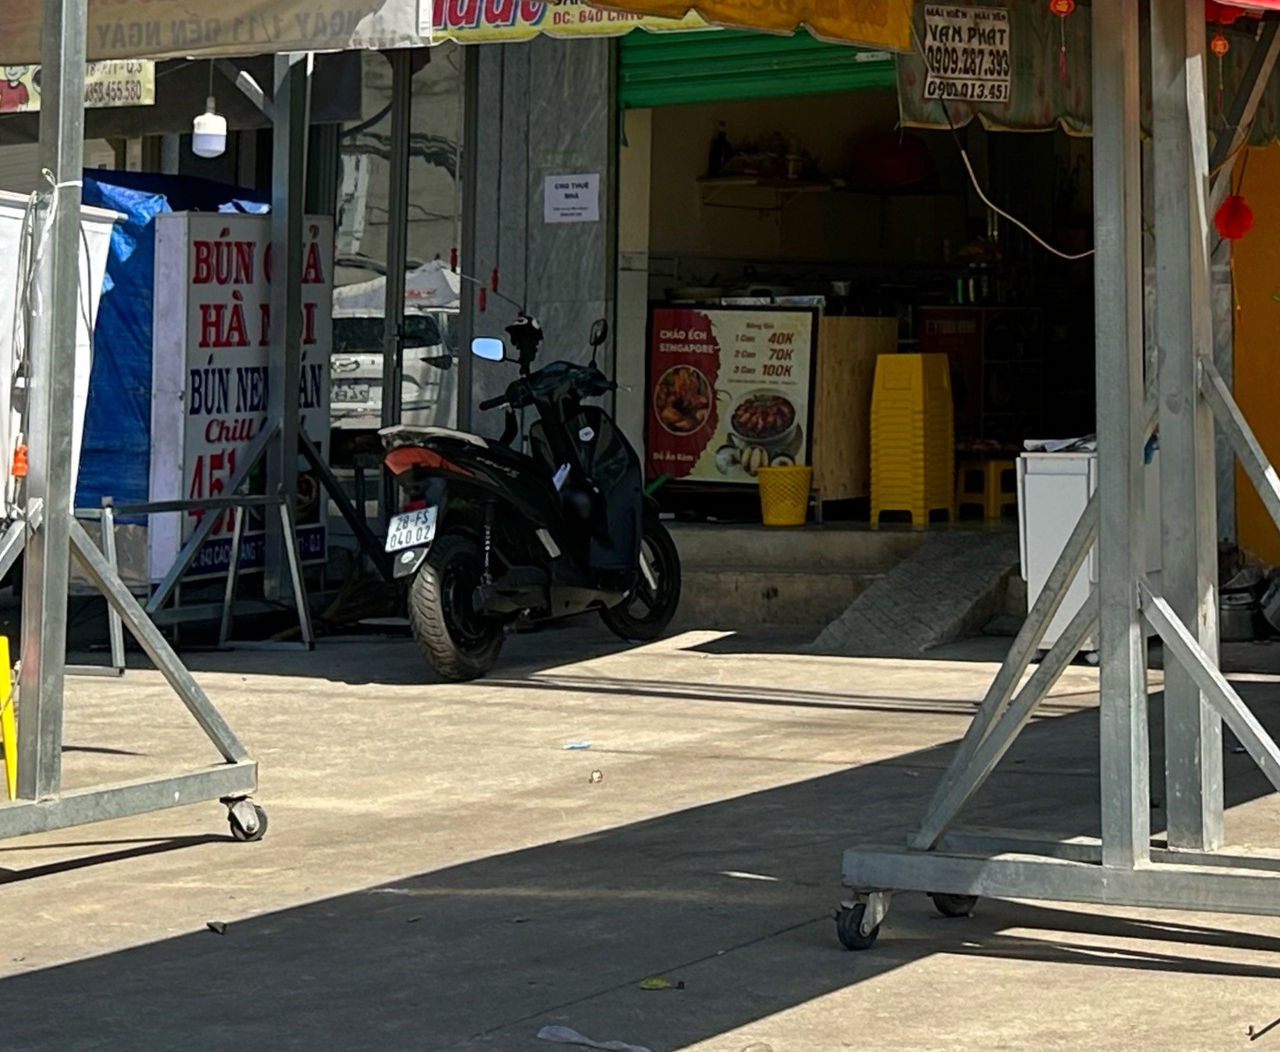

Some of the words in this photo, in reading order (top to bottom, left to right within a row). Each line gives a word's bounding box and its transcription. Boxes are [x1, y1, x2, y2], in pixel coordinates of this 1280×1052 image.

[193, 227, 256, 285] BÚN
[199, 289, 251, 348] HÀ
[768, 332, 795, 345] 40K
[768, 348, 795, 361] 70K
[189, 354, 231, 415] BÚN
[299, 351, 323, 410] ÁN
[762, 364, 793, 377] 100K
